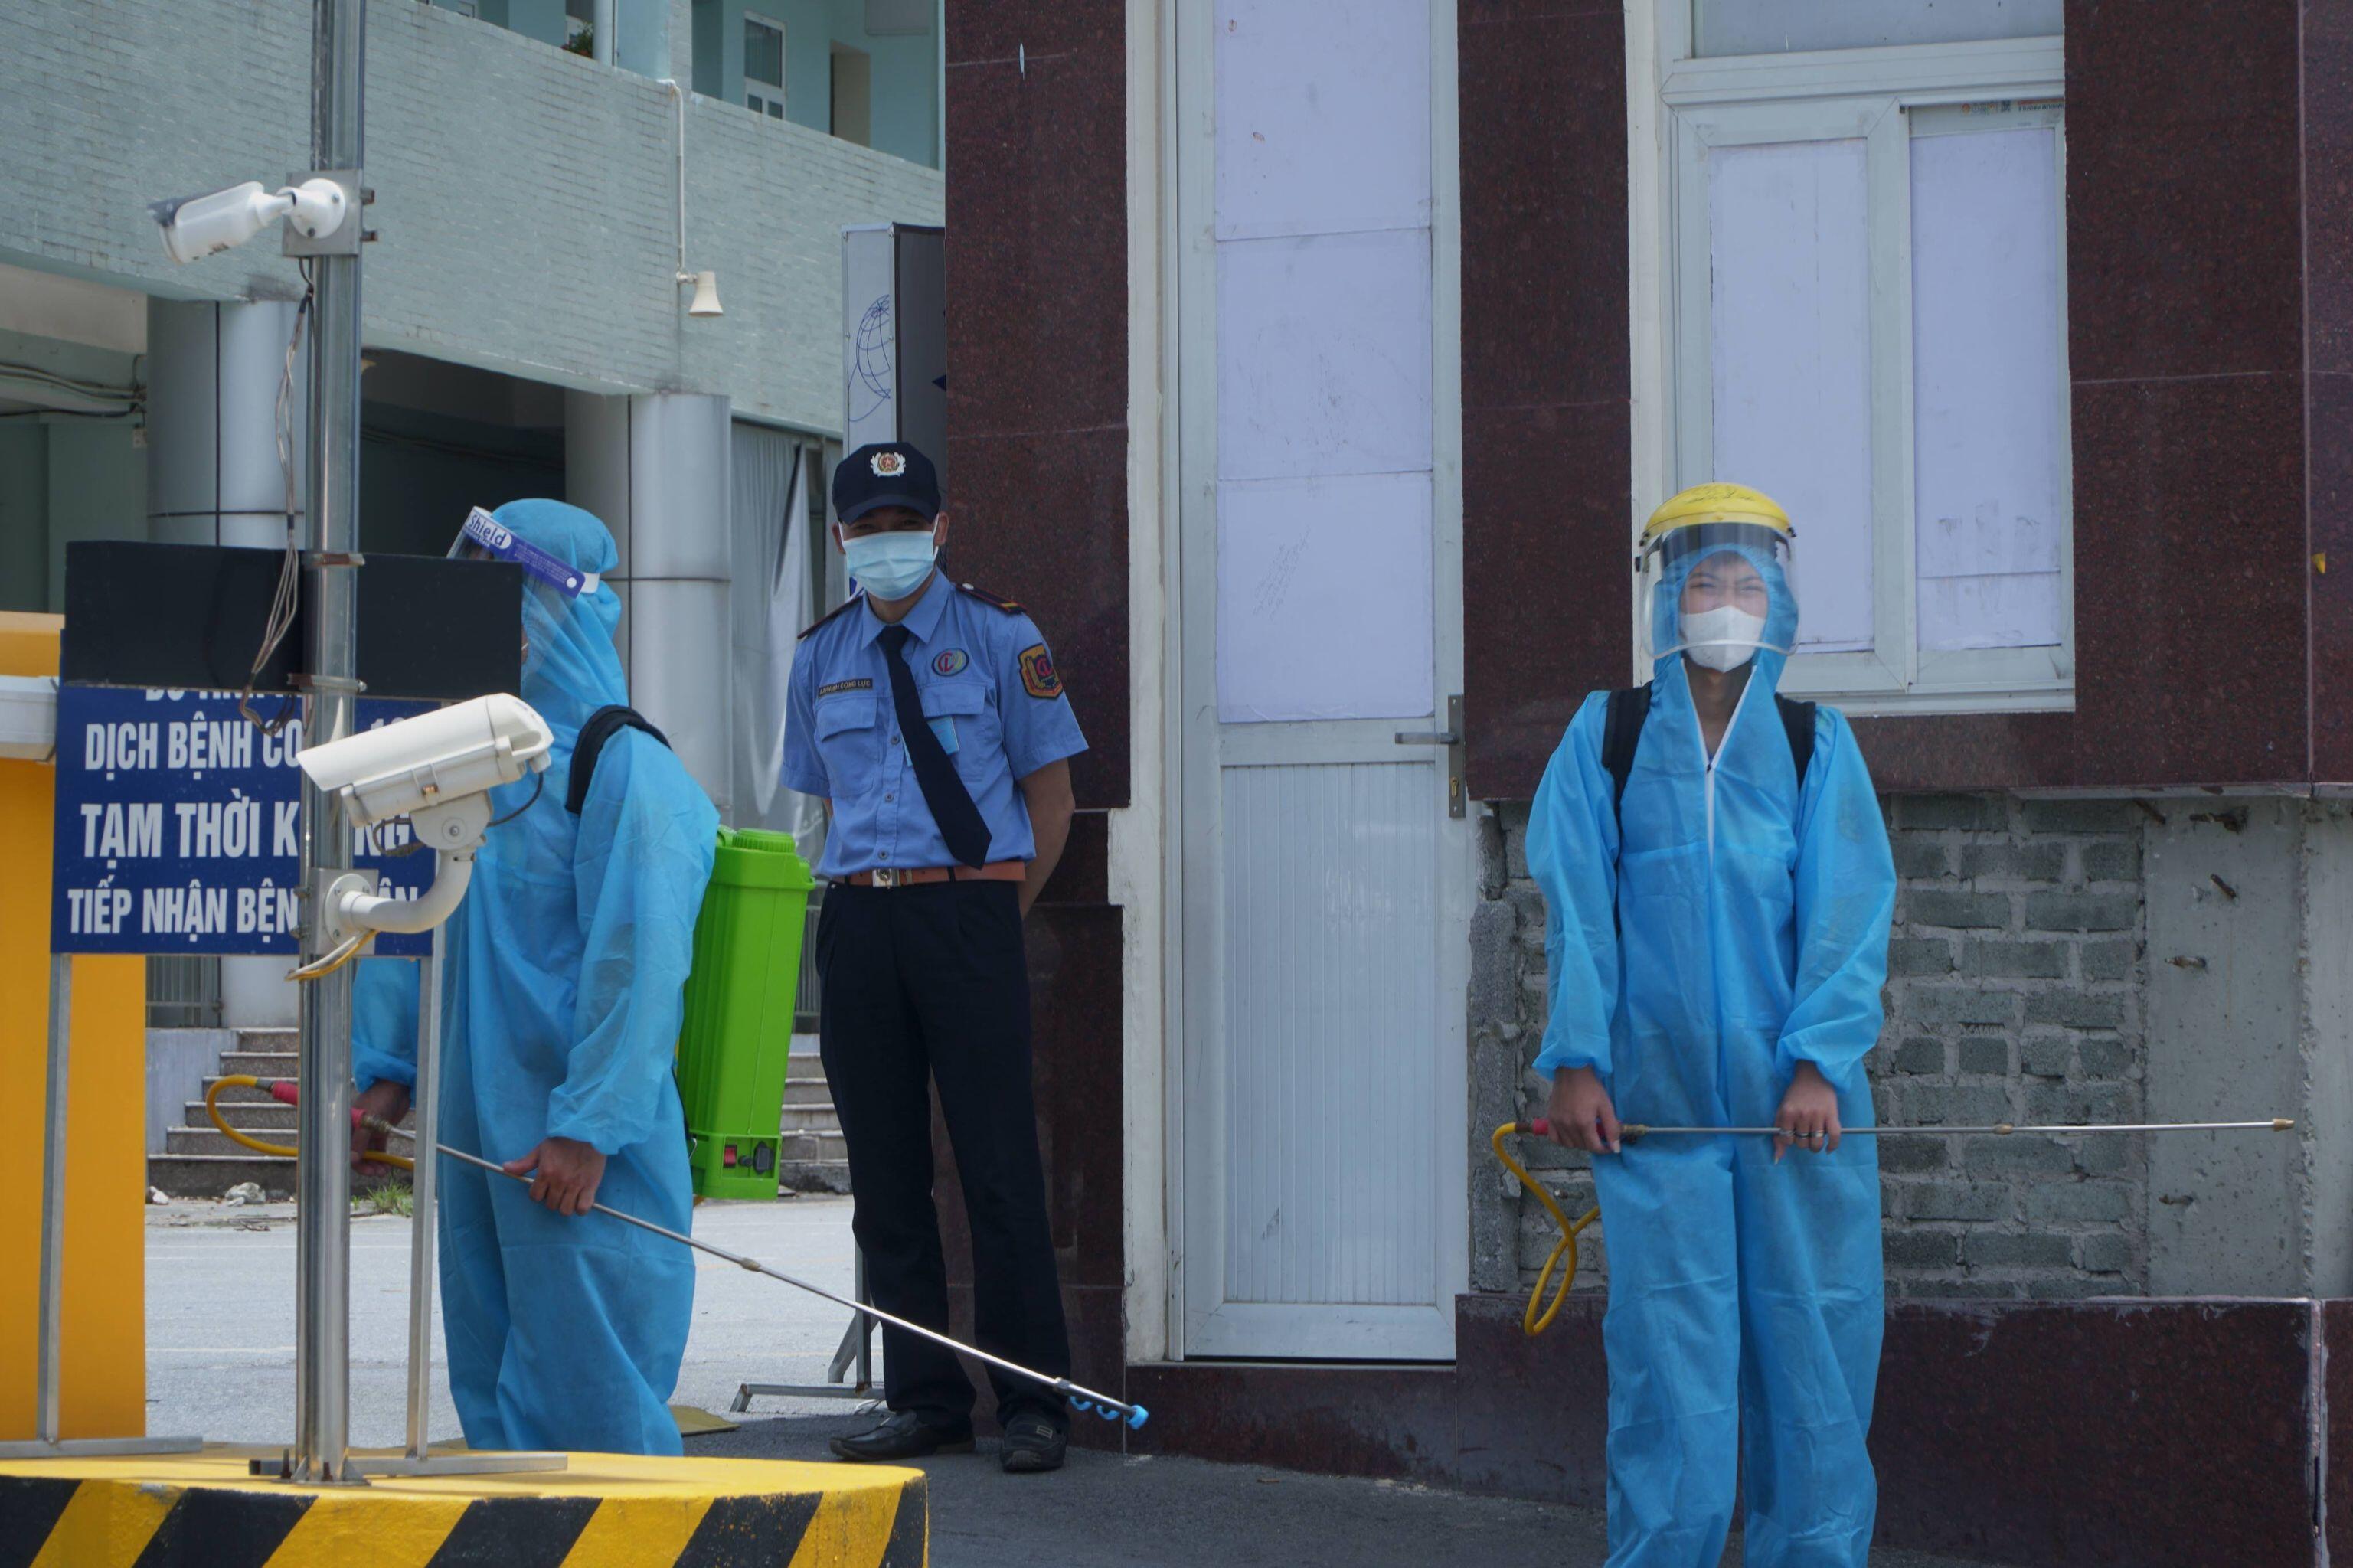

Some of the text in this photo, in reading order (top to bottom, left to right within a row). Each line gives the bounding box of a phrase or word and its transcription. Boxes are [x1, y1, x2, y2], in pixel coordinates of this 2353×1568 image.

[469, 514, 507, 547] Shield
[84, 722, 159, 780] DỊCH
[168, 710, 253, 779] BỆNH
[80, 802, 162, 868] TẠM
[175, 788, 260, 858] THỜI
[67, 874, 299, 943] TIẾP NHẬN BỆN
